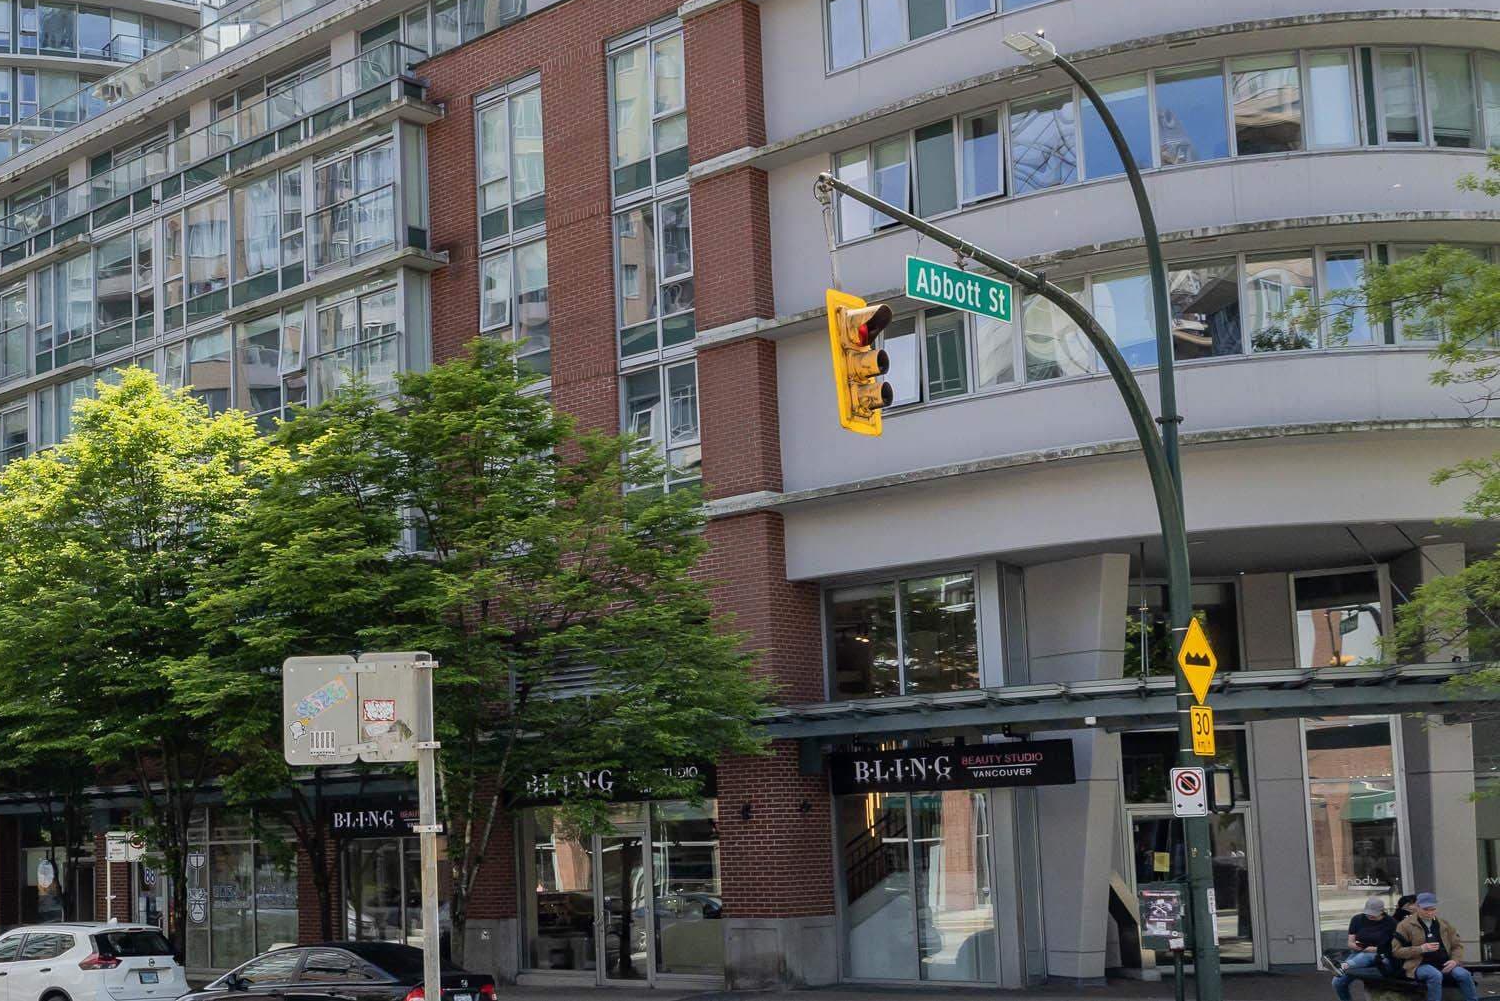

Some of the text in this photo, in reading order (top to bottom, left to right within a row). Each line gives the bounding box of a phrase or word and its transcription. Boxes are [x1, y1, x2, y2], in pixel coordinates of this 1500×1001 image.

[916, 267, 1006, 315] Abbott St
[1195, 712, 1210, 736] 30
[961, 754, 1001, 766] BEAUTY
[1005, 751, 1043, 764] STUDIO
[972, 768, 1032, 778] VANCOUVER
